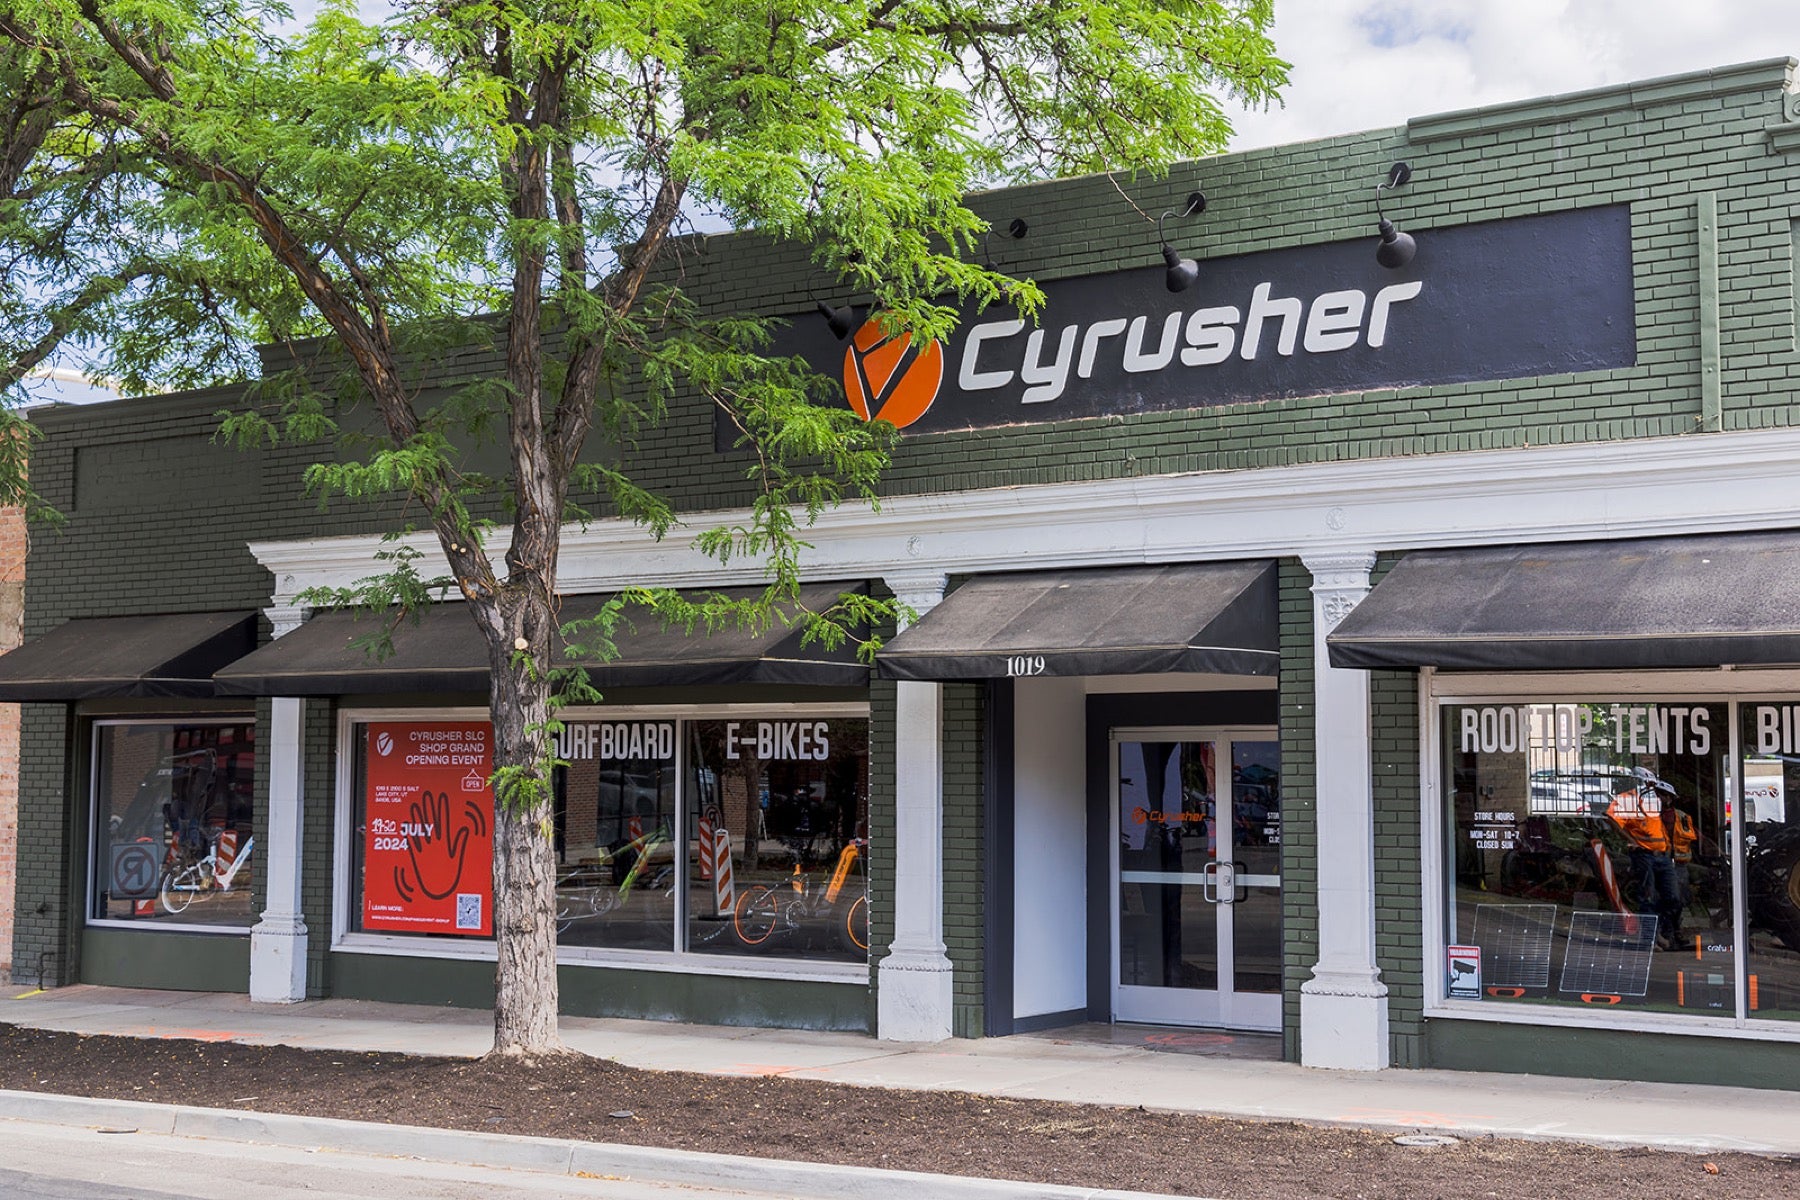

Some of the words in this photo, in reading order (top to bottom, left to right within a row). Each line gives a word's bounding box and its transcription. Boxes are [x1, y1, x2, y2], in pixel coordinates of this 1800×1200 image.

[957, 280, 1423, 404] Cyrusher
[1006, 655, 1046, 677] 1019
[409, 731, 463, 741] CYRUSHER
[464, 730, 485, 741] SLC
[1461, 706, 1593, 753] ROOFTOP
[1610, 706, 1711, 756] TENTS
[420, 743, 447, 753] SHOP
[449, 743, 485, 753] GRAND
[726, 721, 830, 761] E-BIKES
[405, 755, 450, 765] OPENING
[451, 755, 485, 765] EVENT
[1150, 810, 1207, 824] Cyrusher
[1474, 811, 1493, 821] STORE
[1494, 811, 1515, 821] HOURS
[400, 823, 434, 837] JULY
[1470, 830, 1498, 839] MON-SAT
[1504, 830, 1520, 839] 10-7
[374, 837, 409, 851] 2024
[1476, 840, 1499, 849] CLOSED
[1501, 840, 1514, 849] SUN
